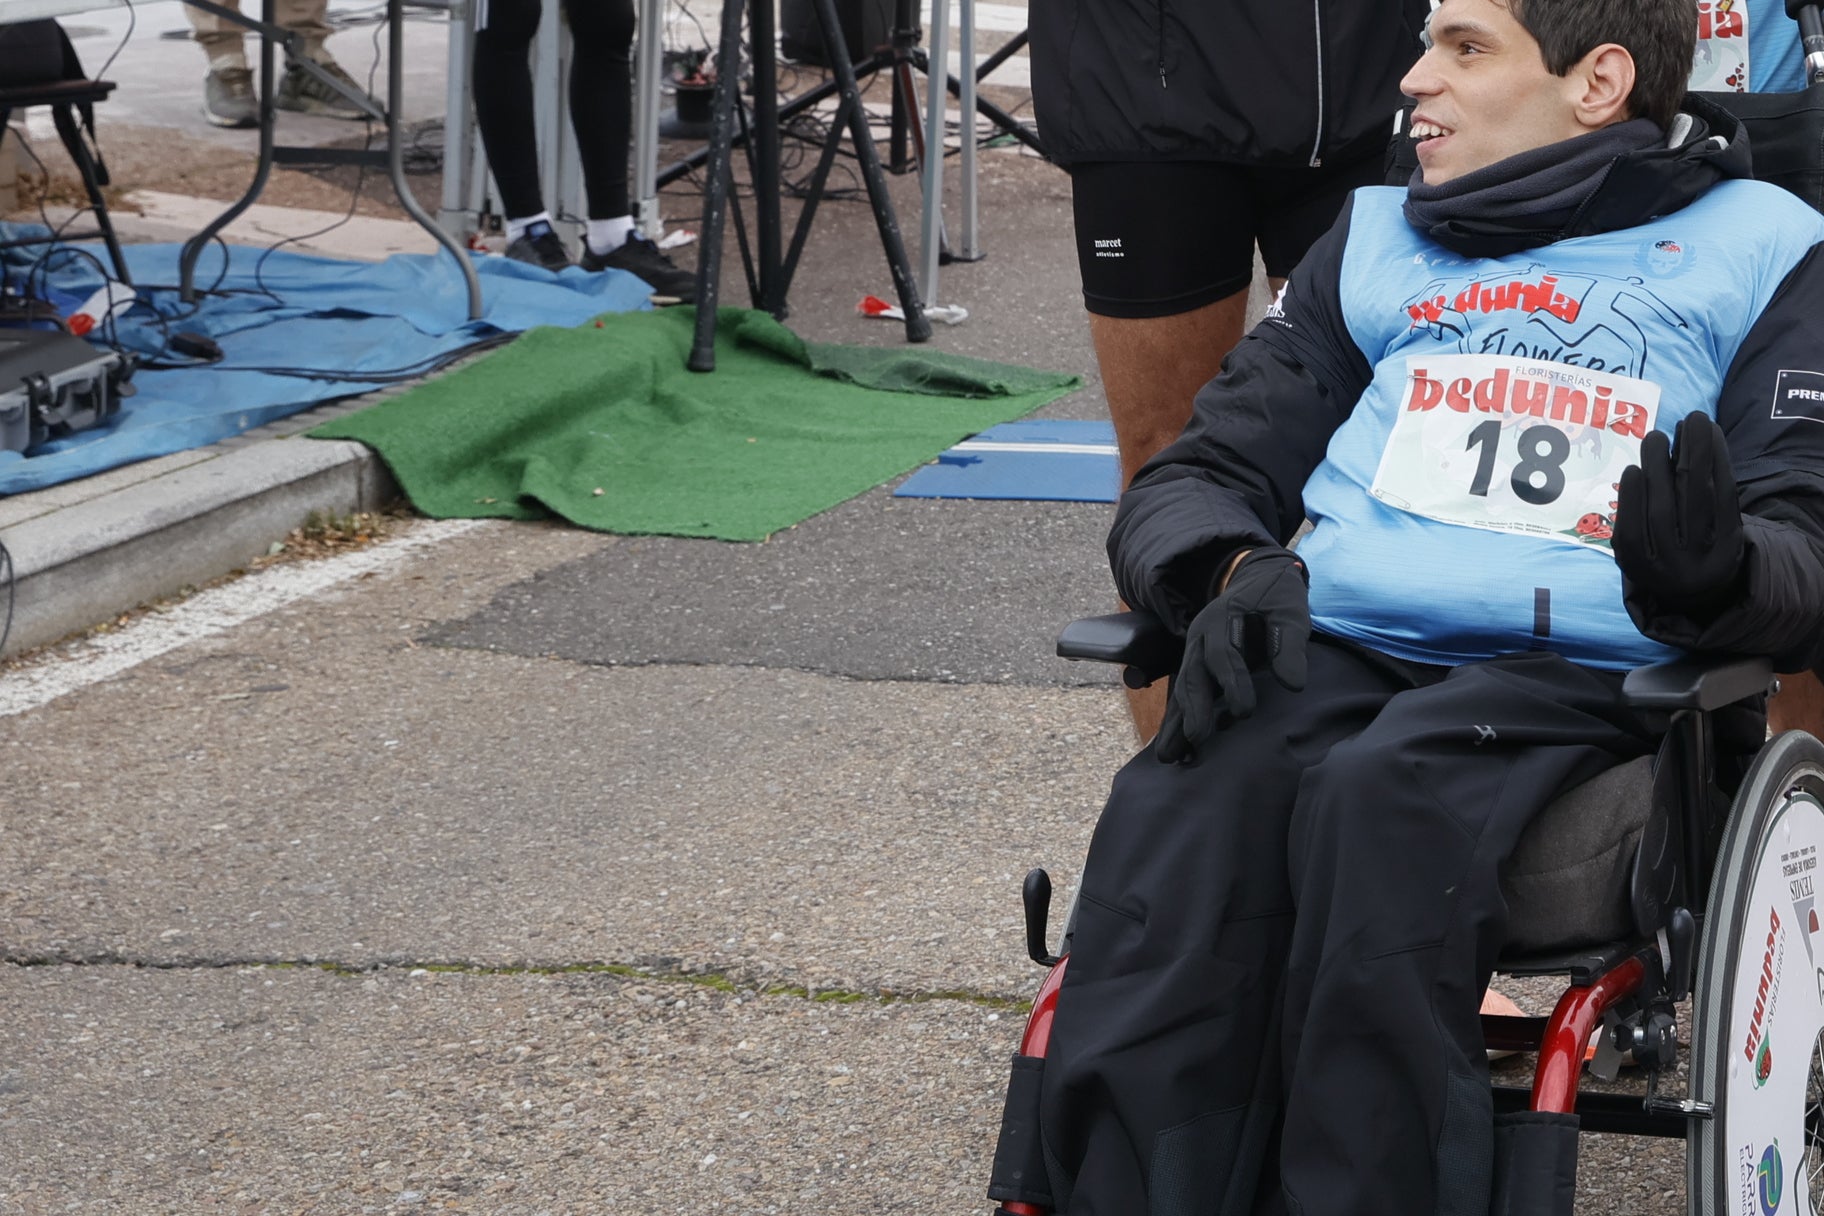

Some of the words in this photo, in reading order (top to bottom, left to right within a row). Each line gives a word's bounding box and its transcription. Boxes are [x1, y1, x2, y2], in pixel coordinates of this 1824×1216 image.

[1406, 368, 1649, 440] bedunia
[1515, 365, 1593, 388] FLORISTERÍAS
[1465, 419, 1571, 506] 18
[1744, 905, 1781, 1063] bedunia
